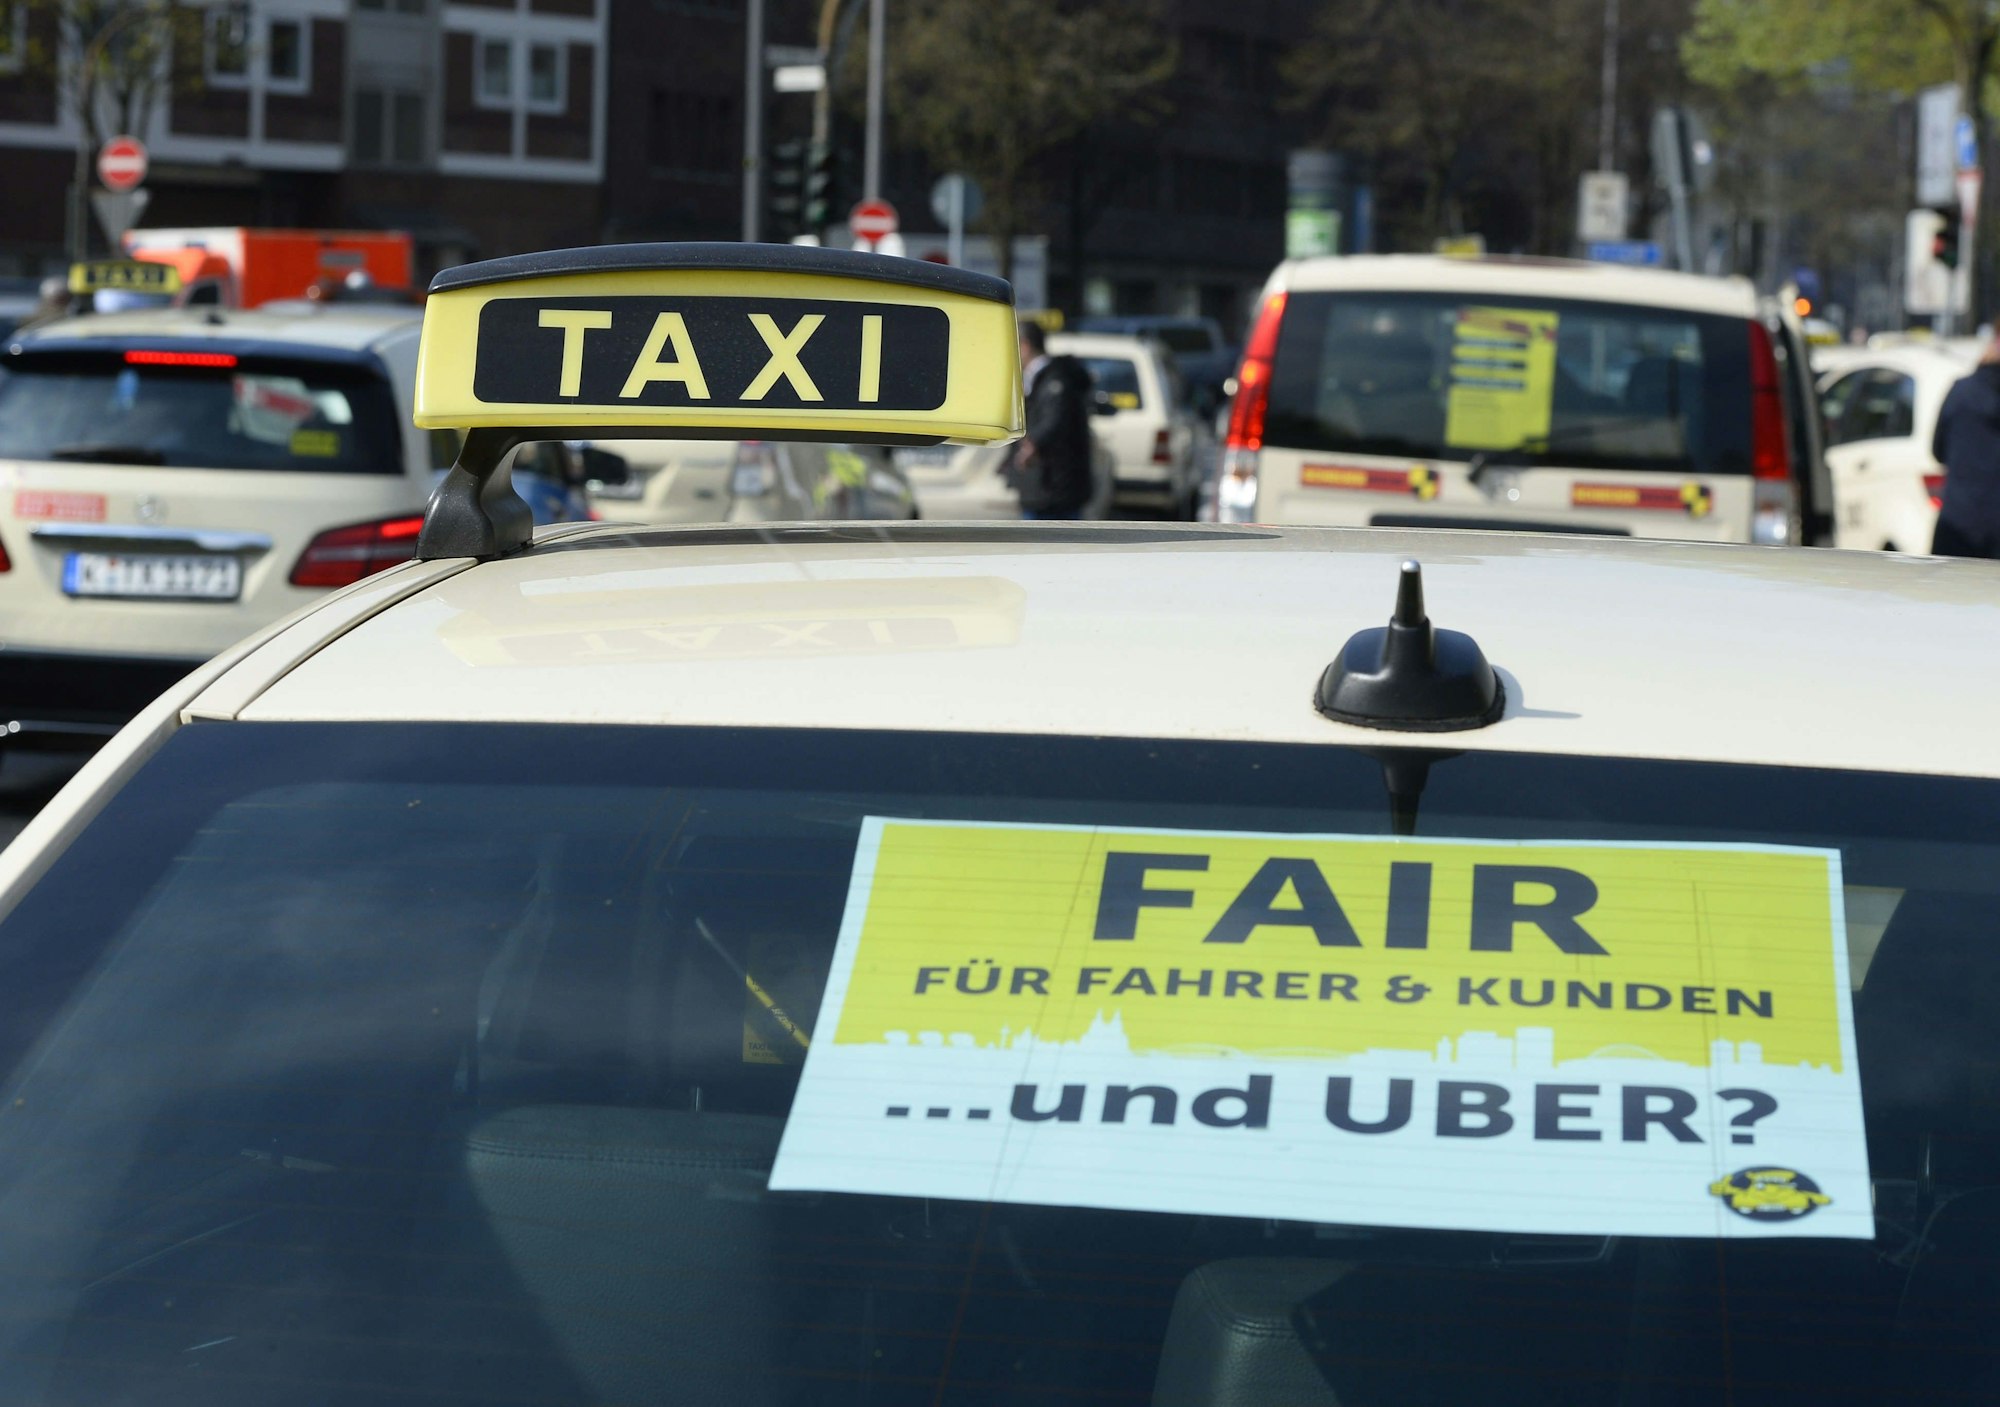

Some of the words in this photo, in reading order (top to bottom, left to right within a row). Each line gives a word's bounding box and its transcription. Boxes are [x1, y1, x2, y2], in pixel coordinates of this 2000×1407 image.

[91, 262, 160, 288] TAXI
[539, 310, 882, 402] TAXI
[1094, 852, 1609, 955] FAIR
[916, 958, 1049, 996] FÜR
[1078, 968, 1358, 1001] FAHRER
[1386, 975, 1431, 1004] &
[1460, 978, 1773, 1018] KUNDEN
[887, 1074, 1273, 1129] ...und
[1326, 1077, 1778, 1145] UBER?
